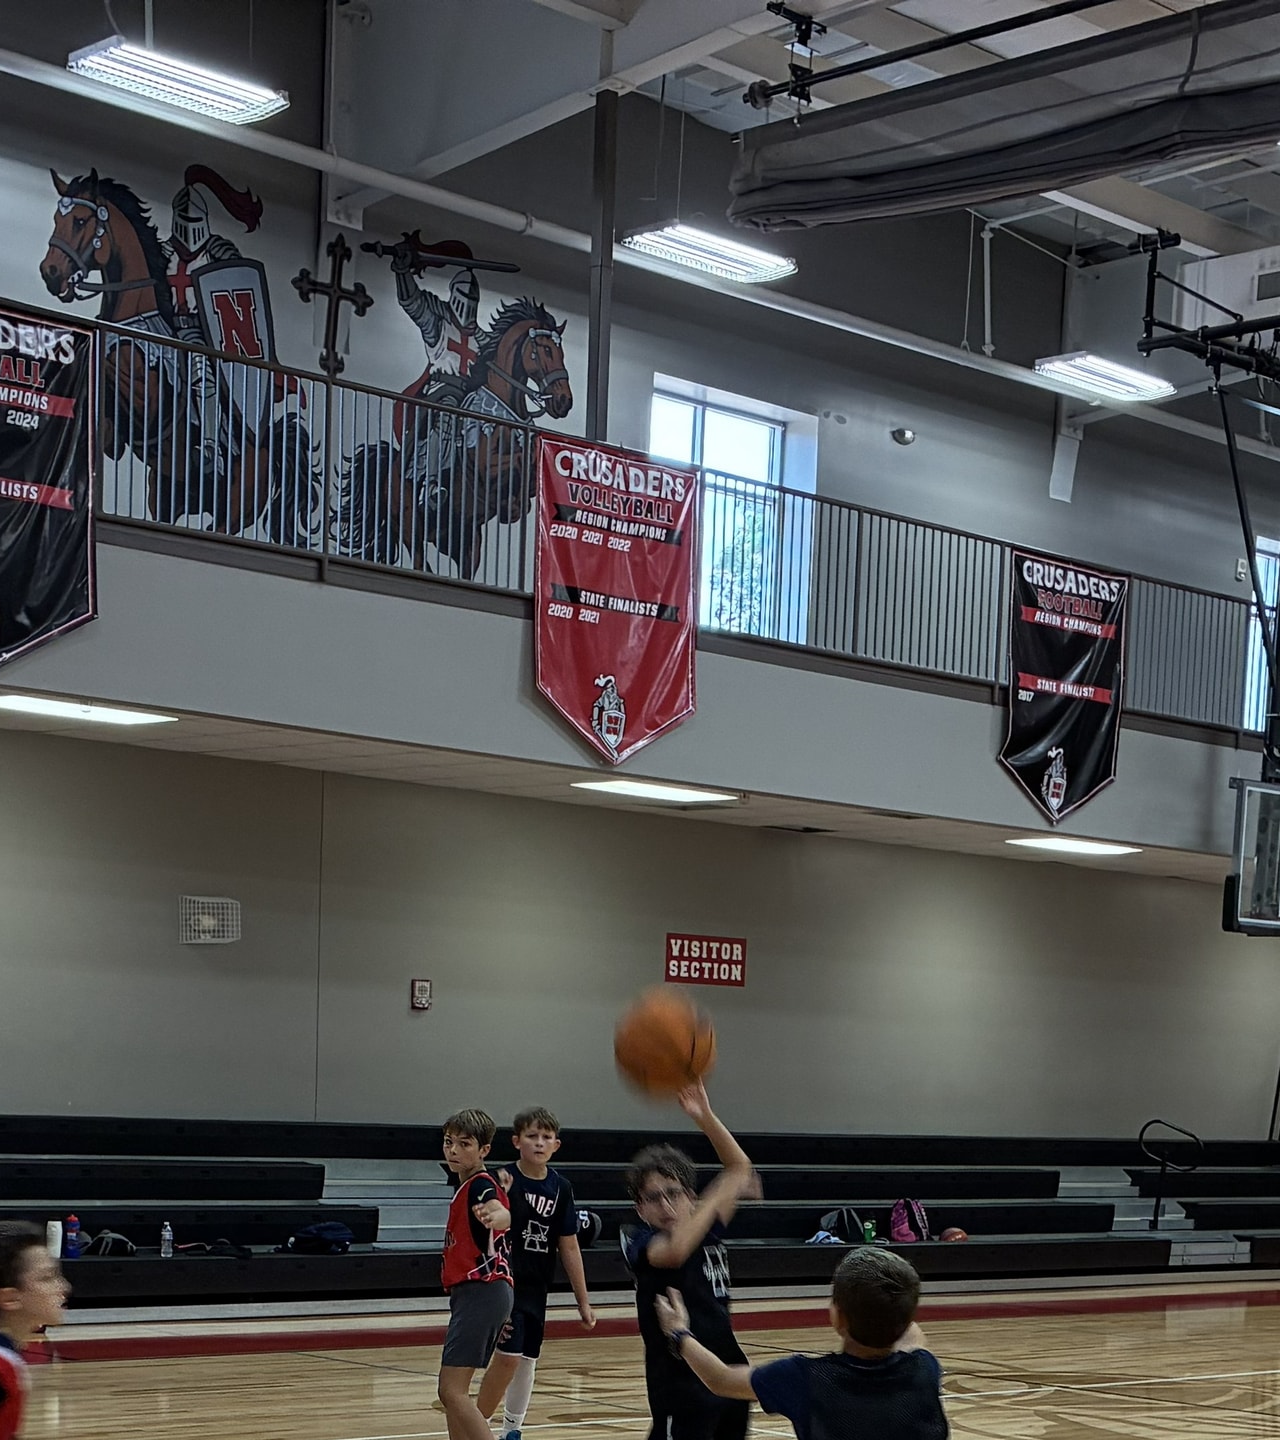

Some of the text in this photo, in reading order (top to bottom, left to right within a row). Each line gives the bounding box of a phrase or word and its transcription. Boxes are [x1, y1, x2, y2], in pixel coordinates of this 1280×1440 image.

[209, 288, 264, 359] N
[6, 409, 40, 430] 2024
[555, 450, 685, 502] CRUSADERS
[567, 482, 674, 525] VOLLEYBALL
[549, 524, 632, 552] 2020 2021 2022
[575, 510, 667, 541] REGION CHAMPIONS
[1022, 560, 1120, 603] CRUSADERS
[548, 603, 600, 624] 2020 2021
[580, 590, 659, 617] STATE FINALISTS
[1037, 588, 1104, 621] FOOTBALL
[1034, 611, 1102, 636] REGION CHAMPIONS
[1037, 679, 1057, 693] STATE
[670, 939, 742, 960] VISITOR
[669, 960, 742, 981] SECTION
